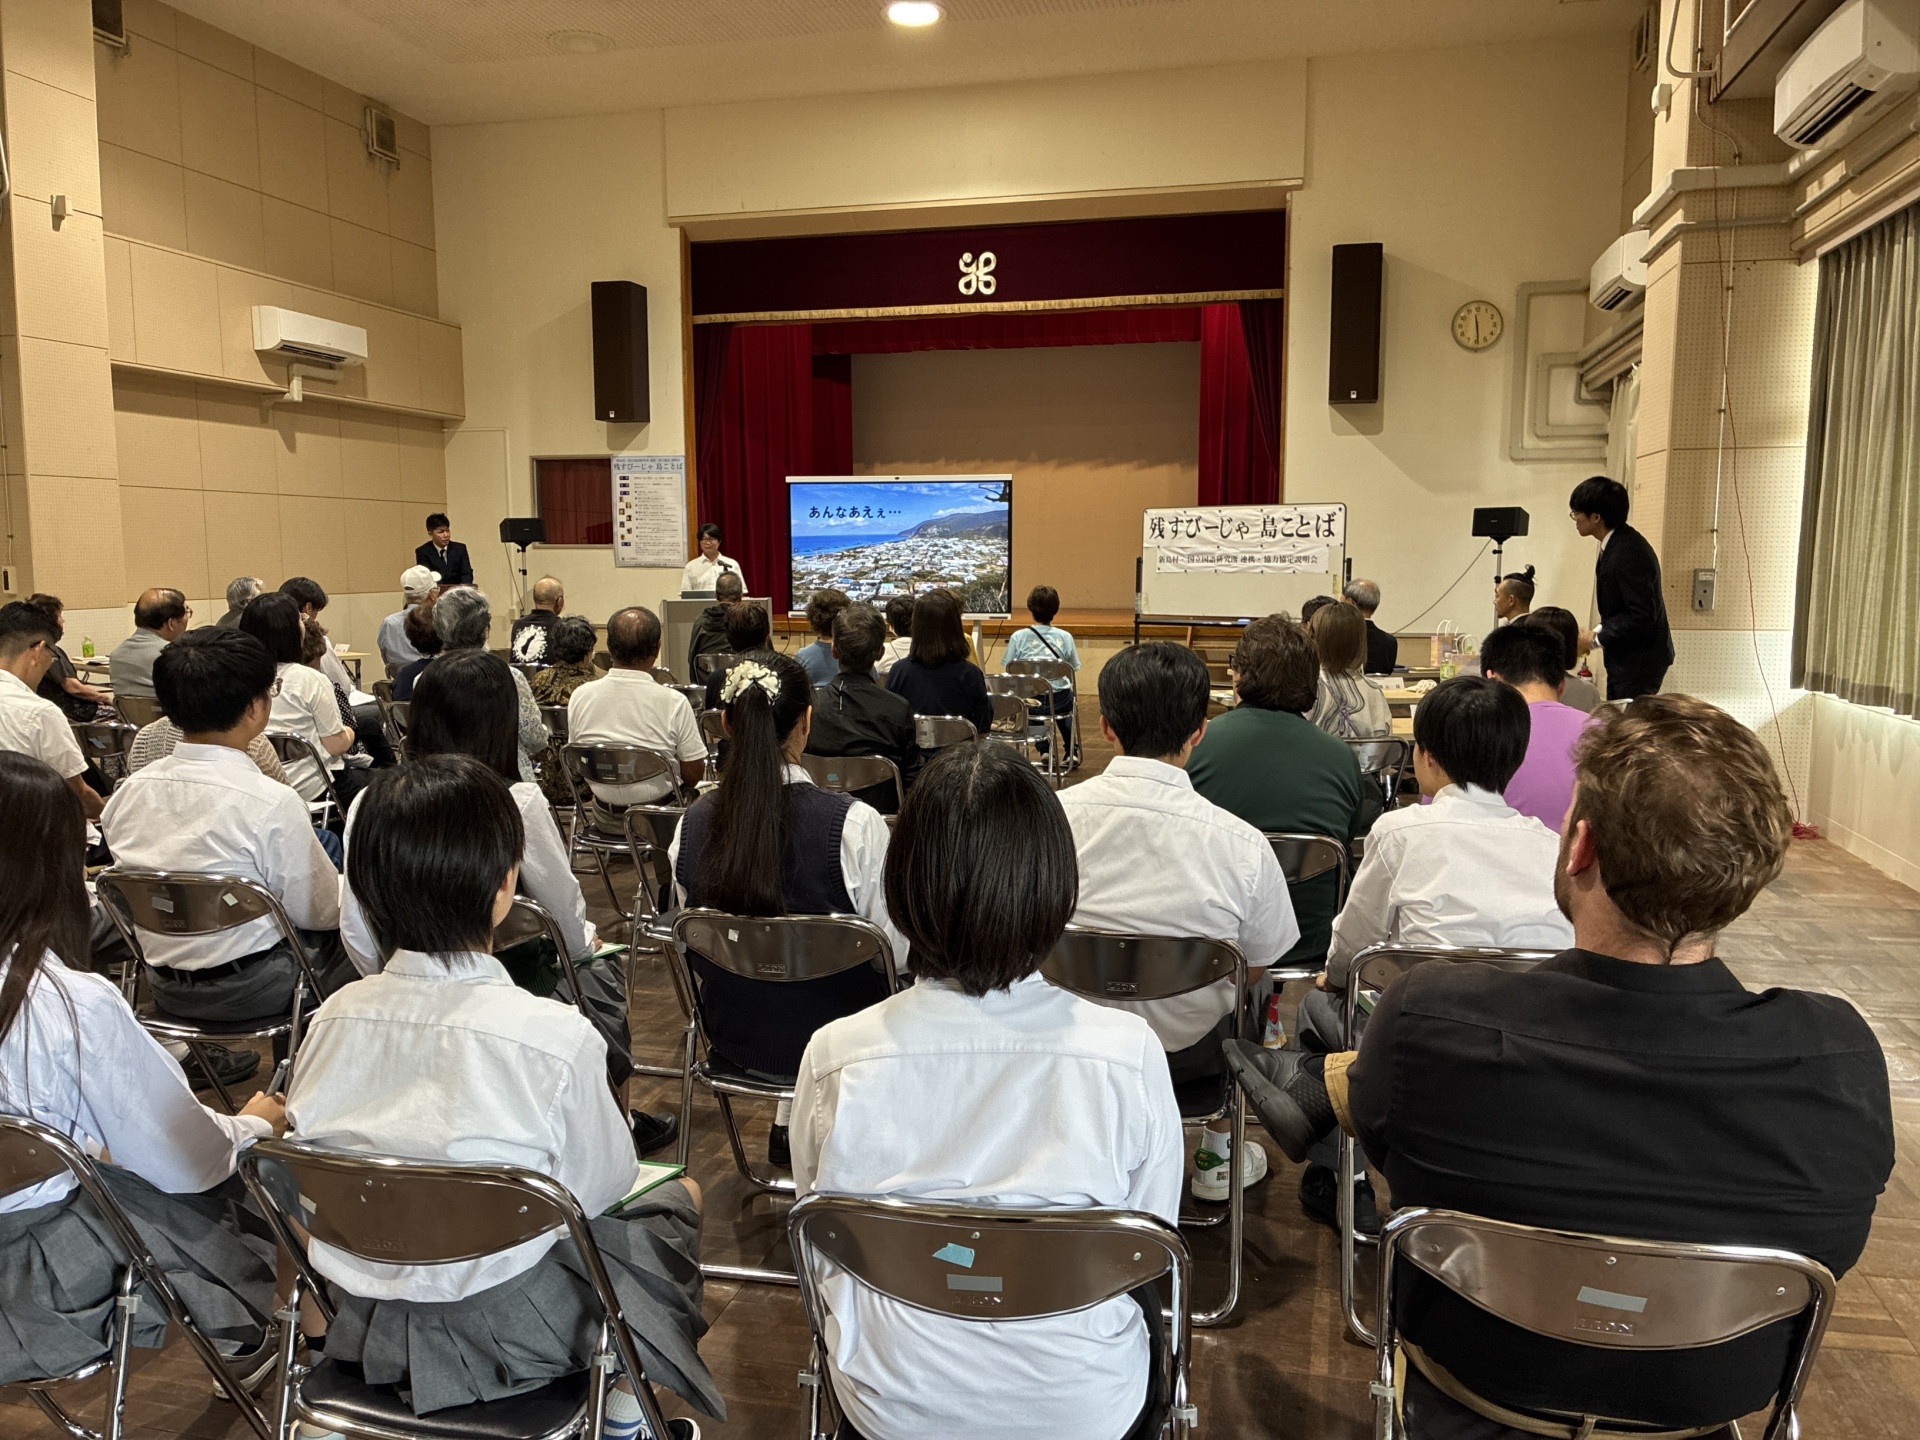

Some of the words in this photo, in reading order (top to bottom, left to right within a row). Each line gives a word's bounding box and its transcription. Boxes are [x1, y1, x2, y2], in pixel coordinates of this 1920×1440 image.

[656, 462, 683, 470] 島ことば
[1149, 516, 1249, 540] 残すびーじゃ
[1261, 511, 1336, 539] 島ことば
